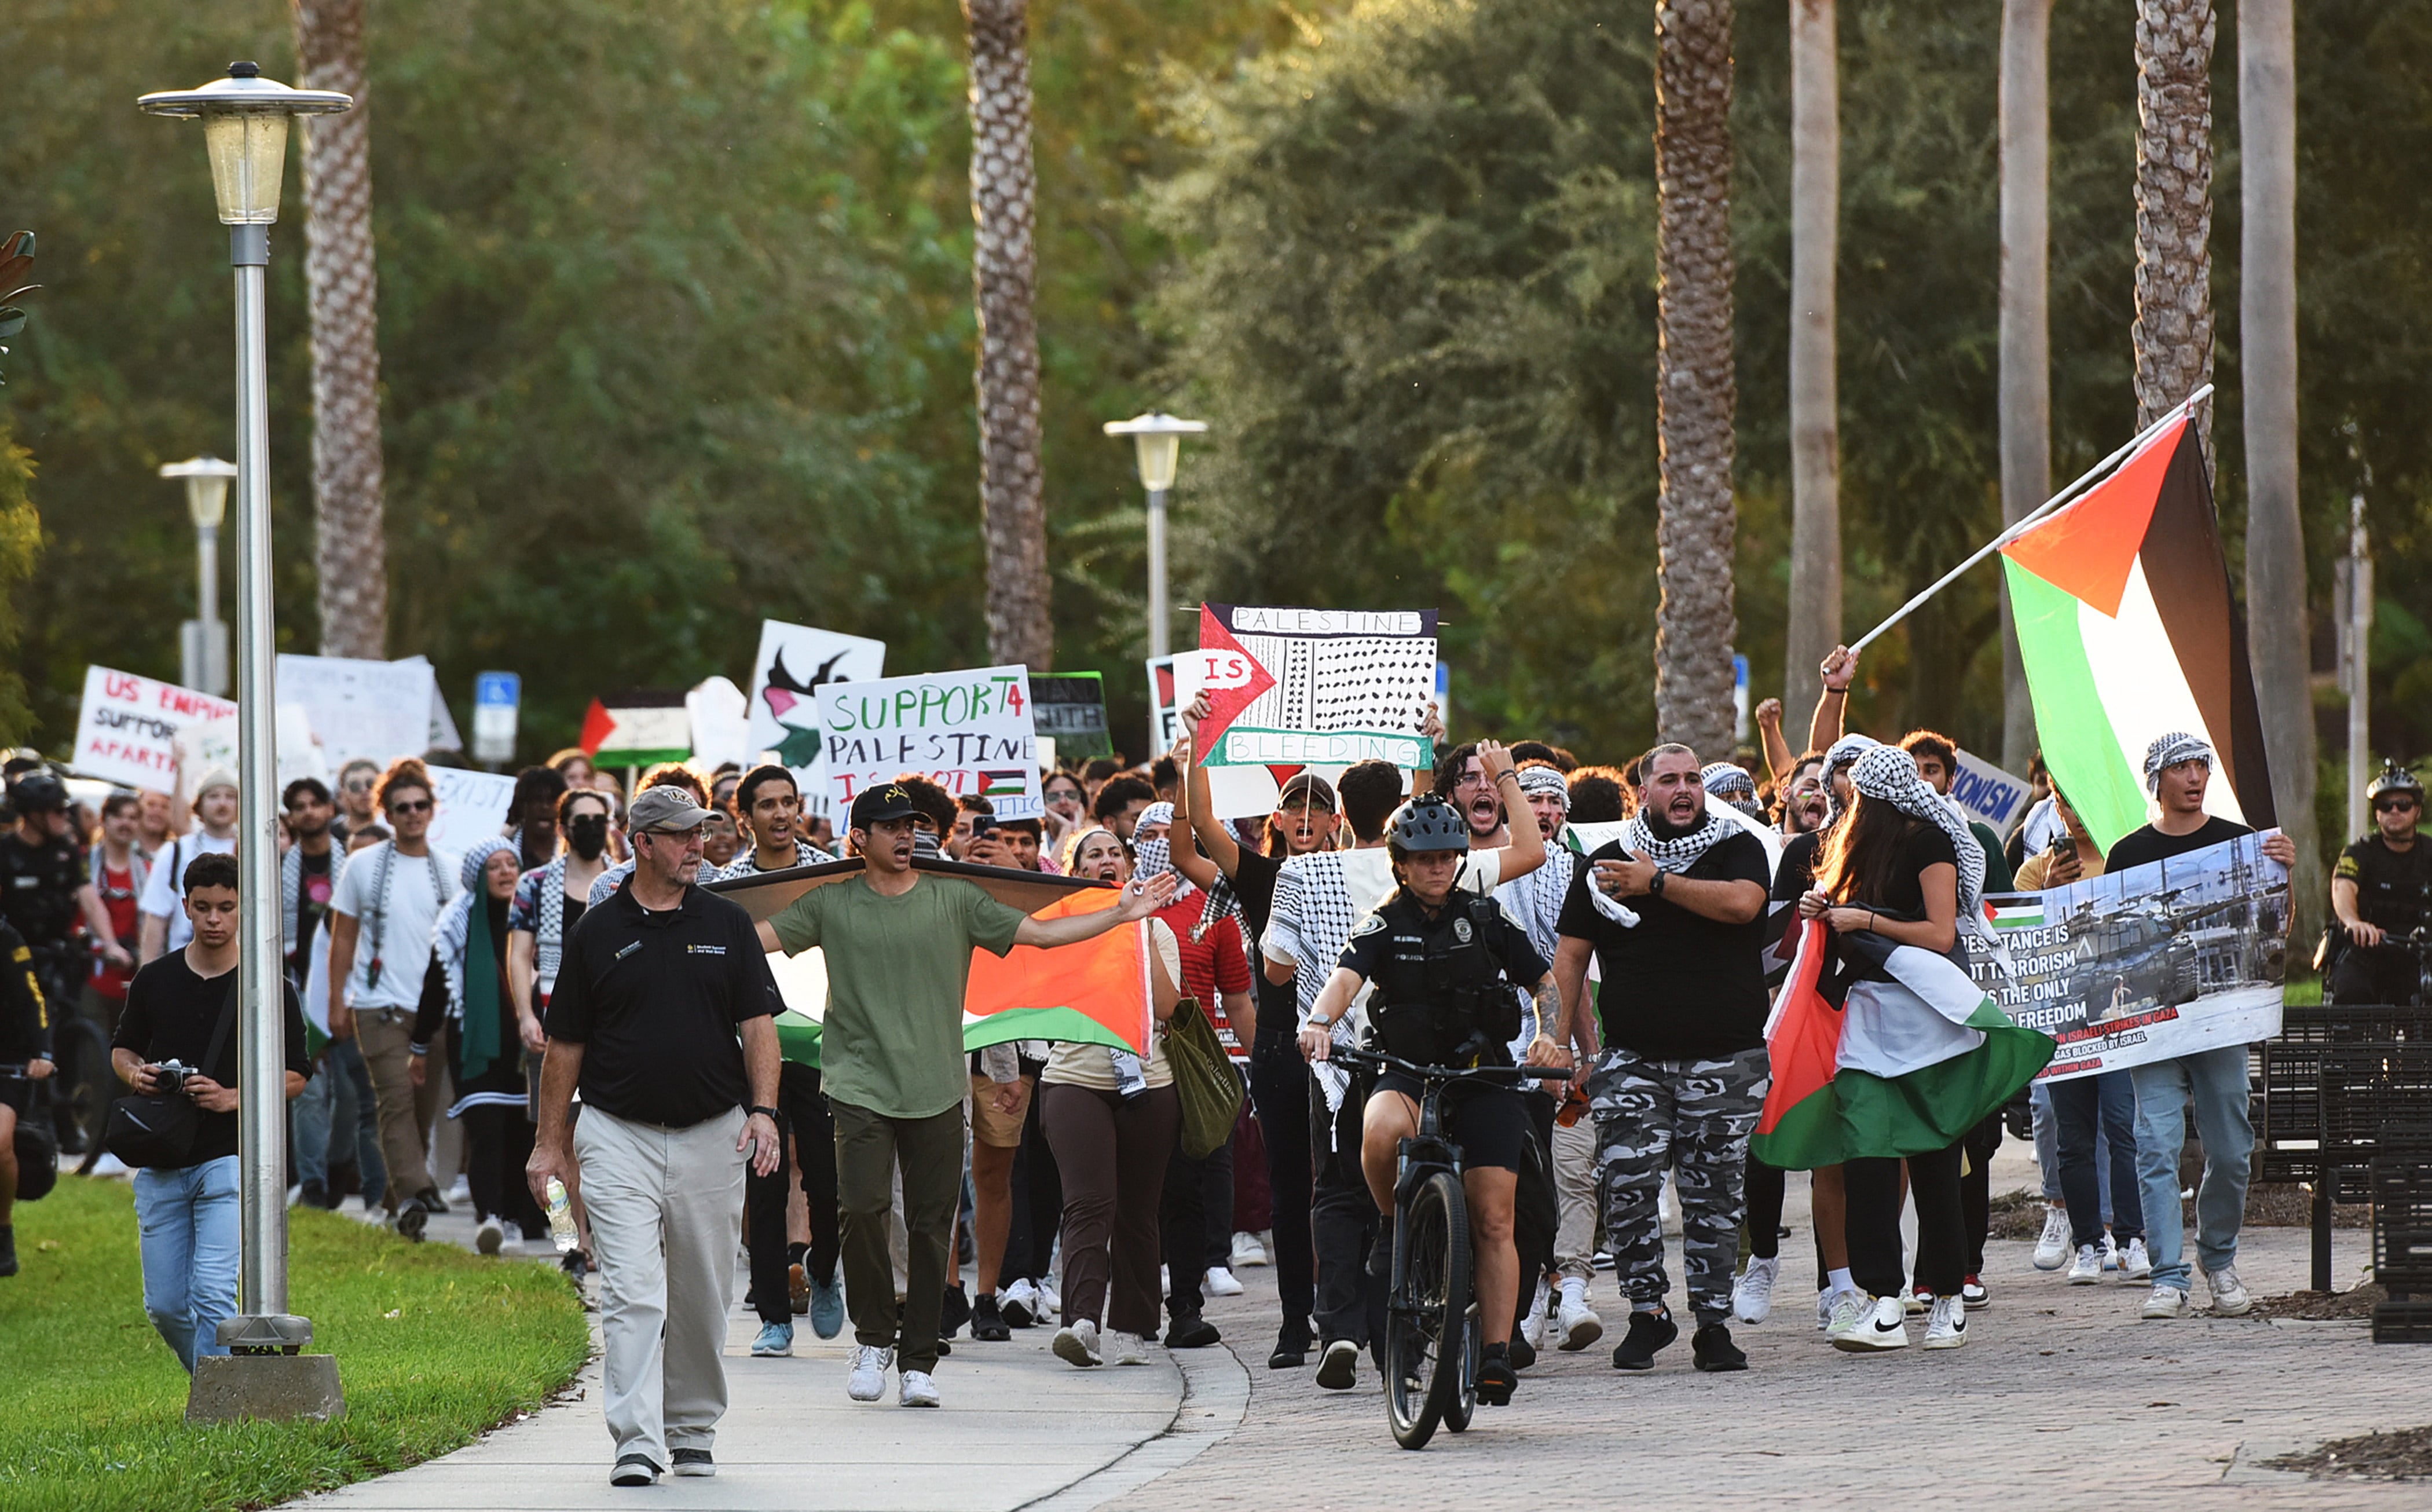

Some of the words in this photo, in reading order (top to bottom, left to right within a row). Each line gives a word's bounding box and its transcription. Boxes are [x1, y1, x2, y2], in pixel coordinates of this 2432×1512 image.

[1236, 609, 1418, 632] PALESTINE
[1204, 658, 1244, 680] IS
[105, 672, 140, 702] US
[827, 676, 1019, 731] SUPPORT
[1007, 684, 1024, 717] 4
[94, 708, 176, 739] SUPPOR
[827, 733, 1035, 766] PALESTINE
[1231, 735, 1417, 764] BLEEDING
[2054, 925, 2070, 944] IS
[2000, 985, 2030, 1006] THE
[2033, 978, 2071, 1001] ONLY
[2017, 1002, 2087, 1029] FREEDOM
[2068, 1027, 2103, 1042] ISRAELI
[2103, 1017, 2141, 1034] STRIKES
[2142, 1013, 2152, 1024] IN
[2153, 1007, 2179, 1022] GAZA
[2054, 1049, 2071, 1060] GAS
[2072, 1042, 2108, 1057] BLOCKED
[2108, 1039, 2119, 1050] BY
[2119, 1030, 2147, 1046] ISRAEL
[2050, 1063, 2079, 1074] WITHIN
[2080, 1057, 2102, 1070] GAZA
